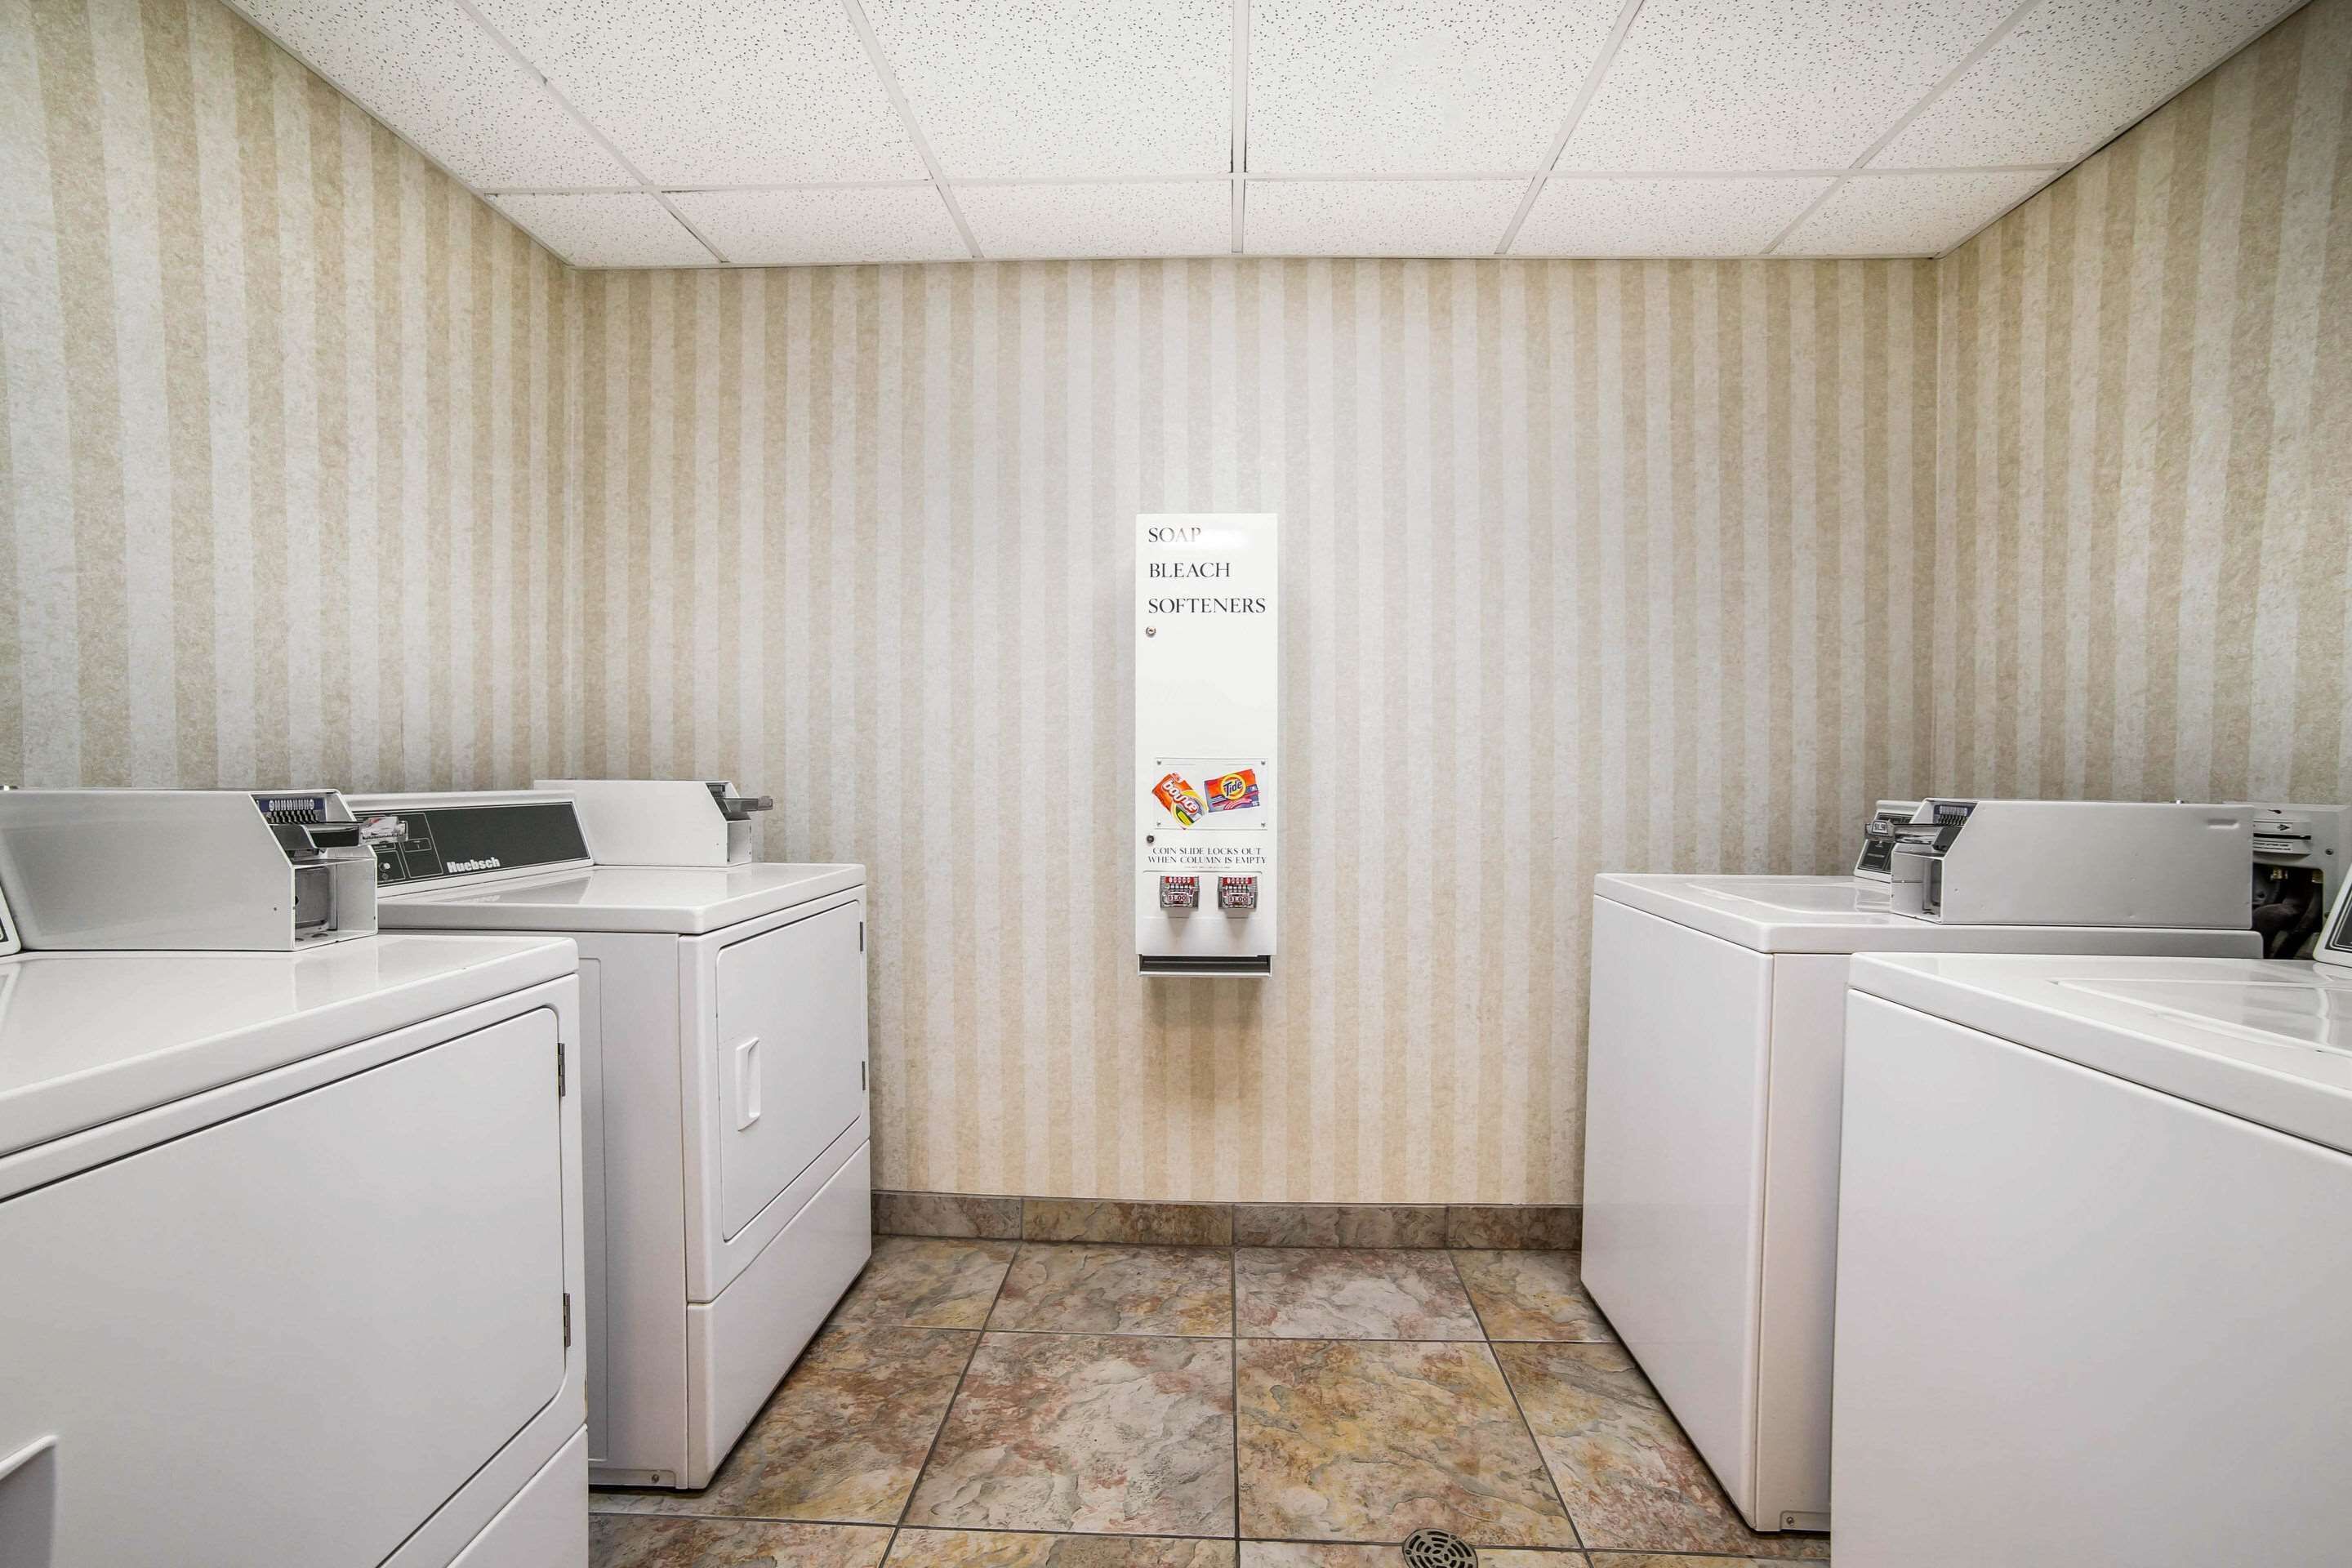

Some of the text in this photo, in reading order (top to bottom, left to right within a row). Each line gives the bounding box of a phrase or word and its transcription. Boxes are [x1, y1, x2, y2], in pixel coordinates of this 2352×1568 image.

[1148, 528, 1201, 542] SOAP
[1149, 562, 1231, 578] BLEACH
[1148, 598, 1266, 613] SOFTENERS
[1223, 779, 1243, 797] Tide
[447, 857, 501, 873] Huebsch
[1180, 856, 1222, 864] COLUMN
[1224, 856, 1232, 864] IS
[1236, 856, 1267, 864] EMPTY
